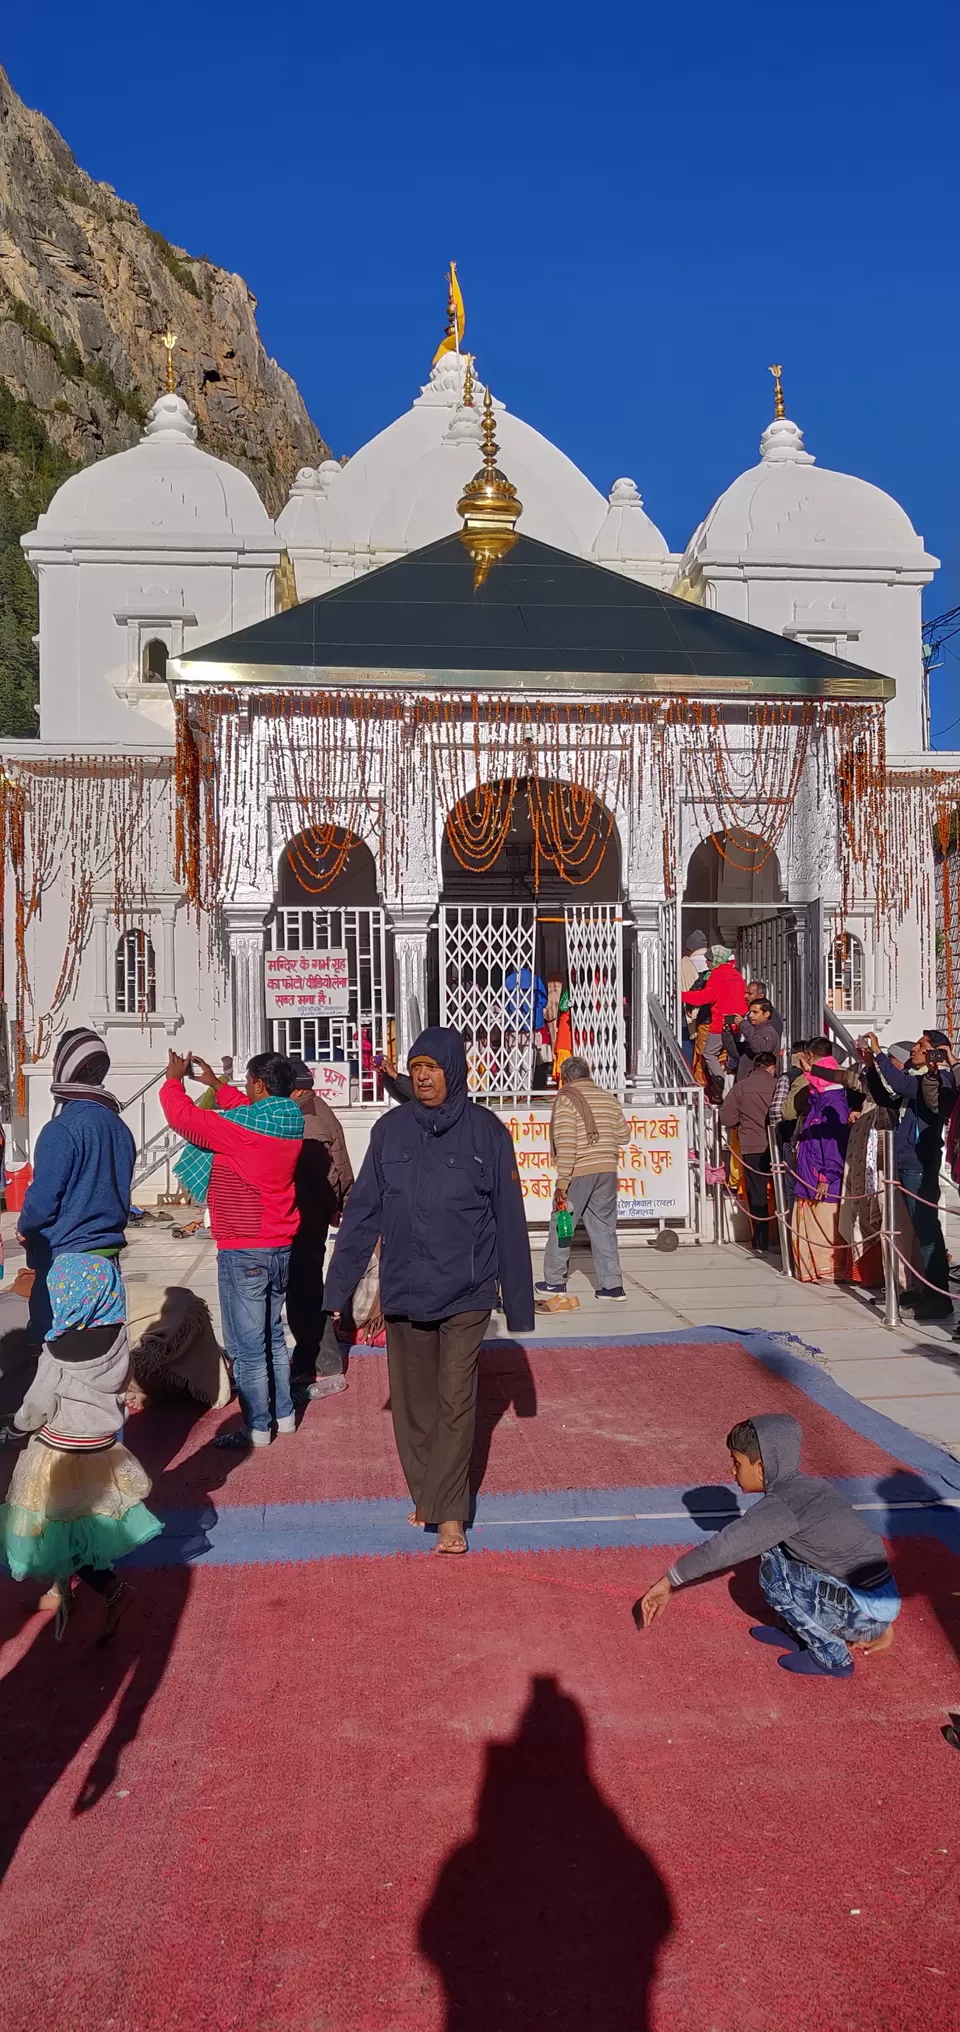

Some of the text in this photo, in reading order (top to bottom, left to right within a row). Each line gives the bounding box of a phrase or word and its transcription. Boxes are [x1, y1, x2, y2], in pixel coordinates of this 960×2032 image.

[267, 956, 346, 973] मन्दिर के गर्भ गृह
[296, 994, 316, 1005] मना
[323, 1067, 346, 1089] पूजा
[647, 1150, 672, 1174] पुनः
[529, 1174, 553, 1198] बजे
[628, 1208, 655, 1217] हिमालय
